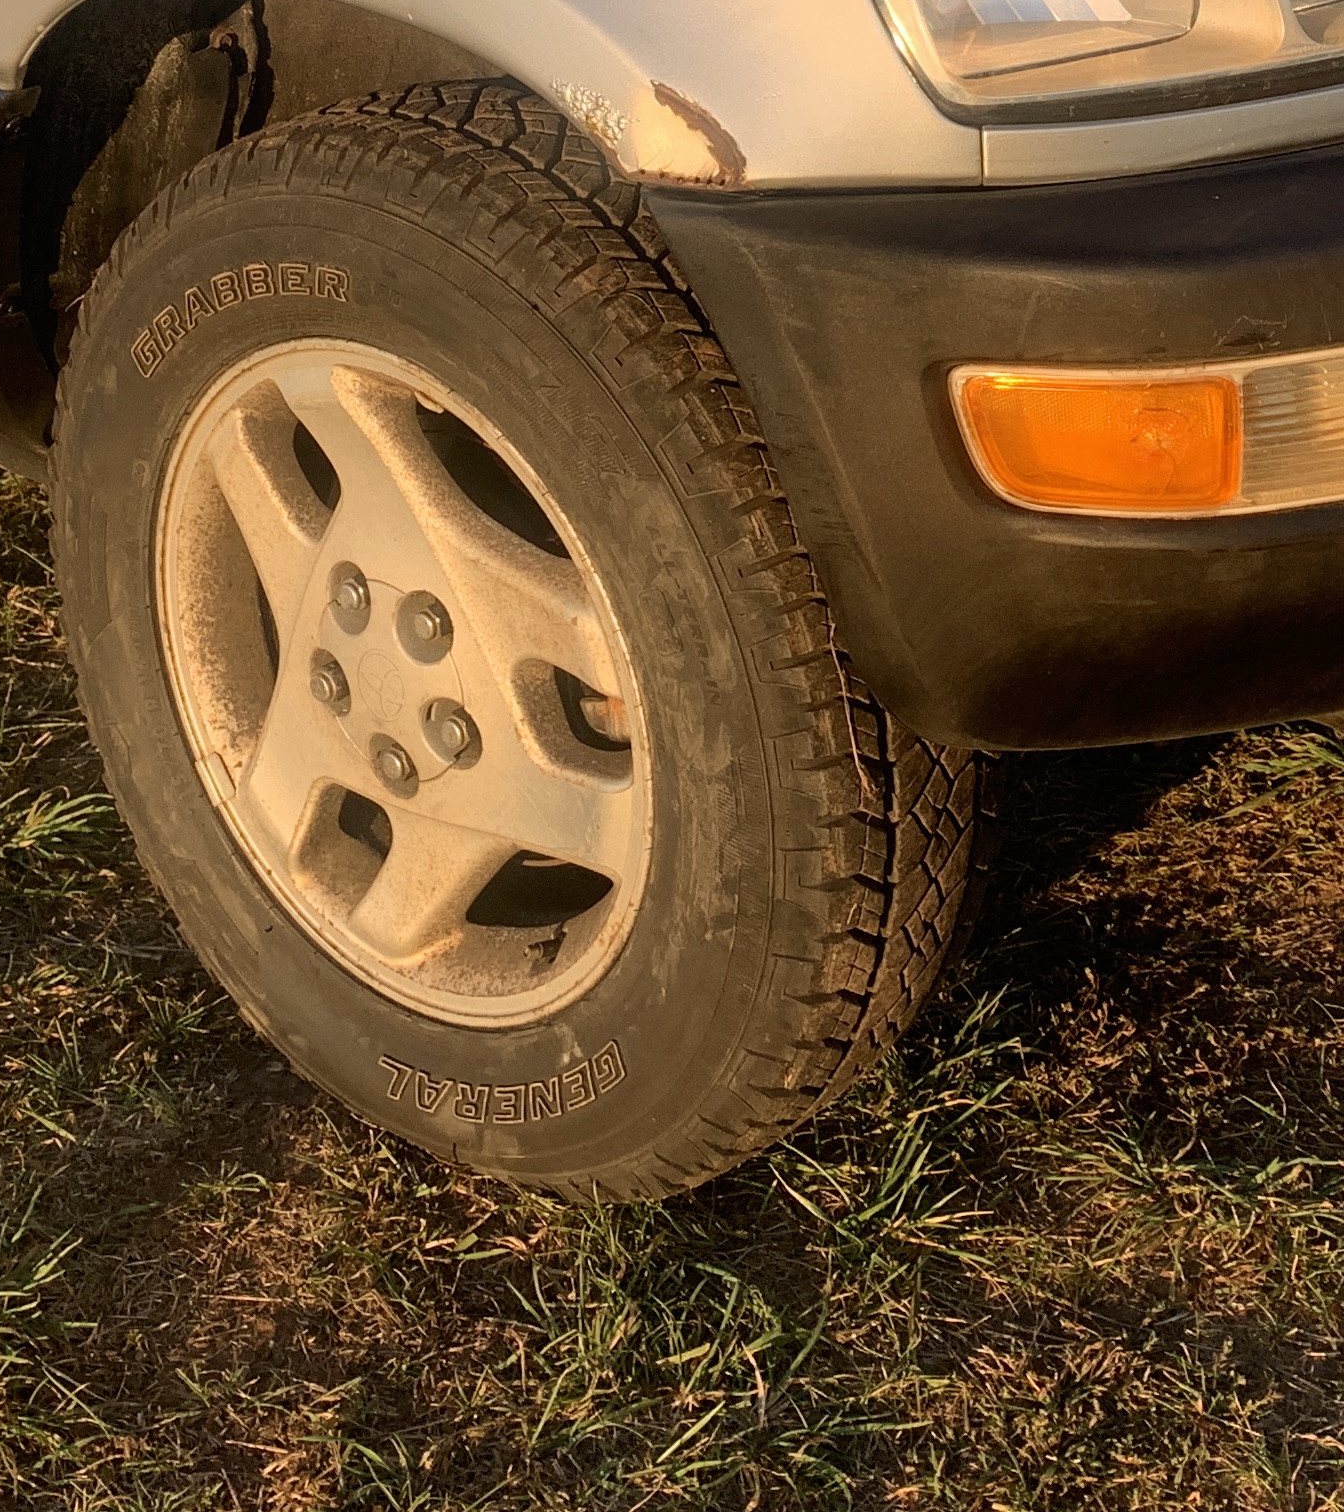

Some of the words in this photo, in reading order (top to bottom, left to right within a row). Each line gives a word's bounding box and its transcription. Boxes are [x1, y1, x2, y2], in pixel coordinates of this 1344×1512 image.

[130, 260, 352, 379] GRABBER
[645, 525, 723, 706] ALL-TERRAIN
[377, 1039, 627, 1126] GENERAL
